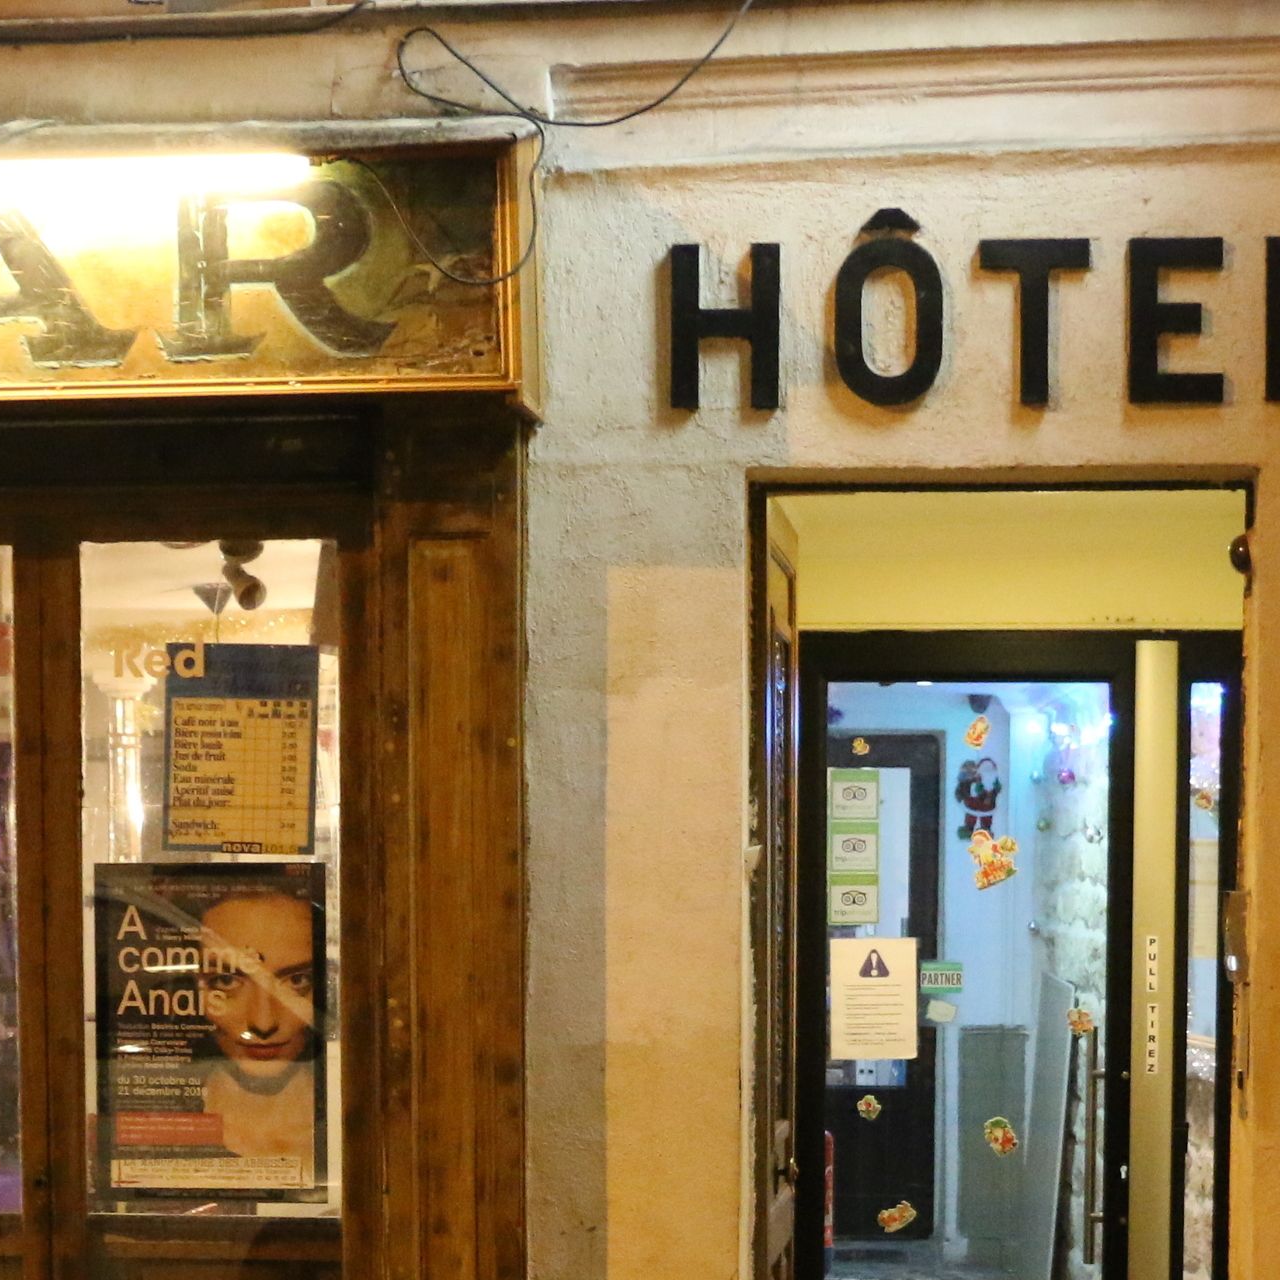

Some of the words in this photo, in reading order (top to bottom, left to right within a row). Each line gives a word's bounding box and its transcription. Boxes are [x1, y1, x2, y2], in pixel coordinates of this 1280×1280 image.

[173, 763, 198, 773] Soda
[173, 774, 193, 784] Eau
[222, 842, 261, 853] nova
[116, 904, 148, 941] A
[117, 946, 263, 974] comme
[1148, 938, 1157, 991] PULL
[921, 972, 962, 986] PARTNER
[1147, 1005, 1157, 1073] TIREZ
[117, 1076, 131, 1085] du
[133, 1076, 147, 1085] 30
[148, 1075, 186, 1085] octobre
[187, 1077, 201, 1085] au
[117, 1086, 130, 1096] 21
